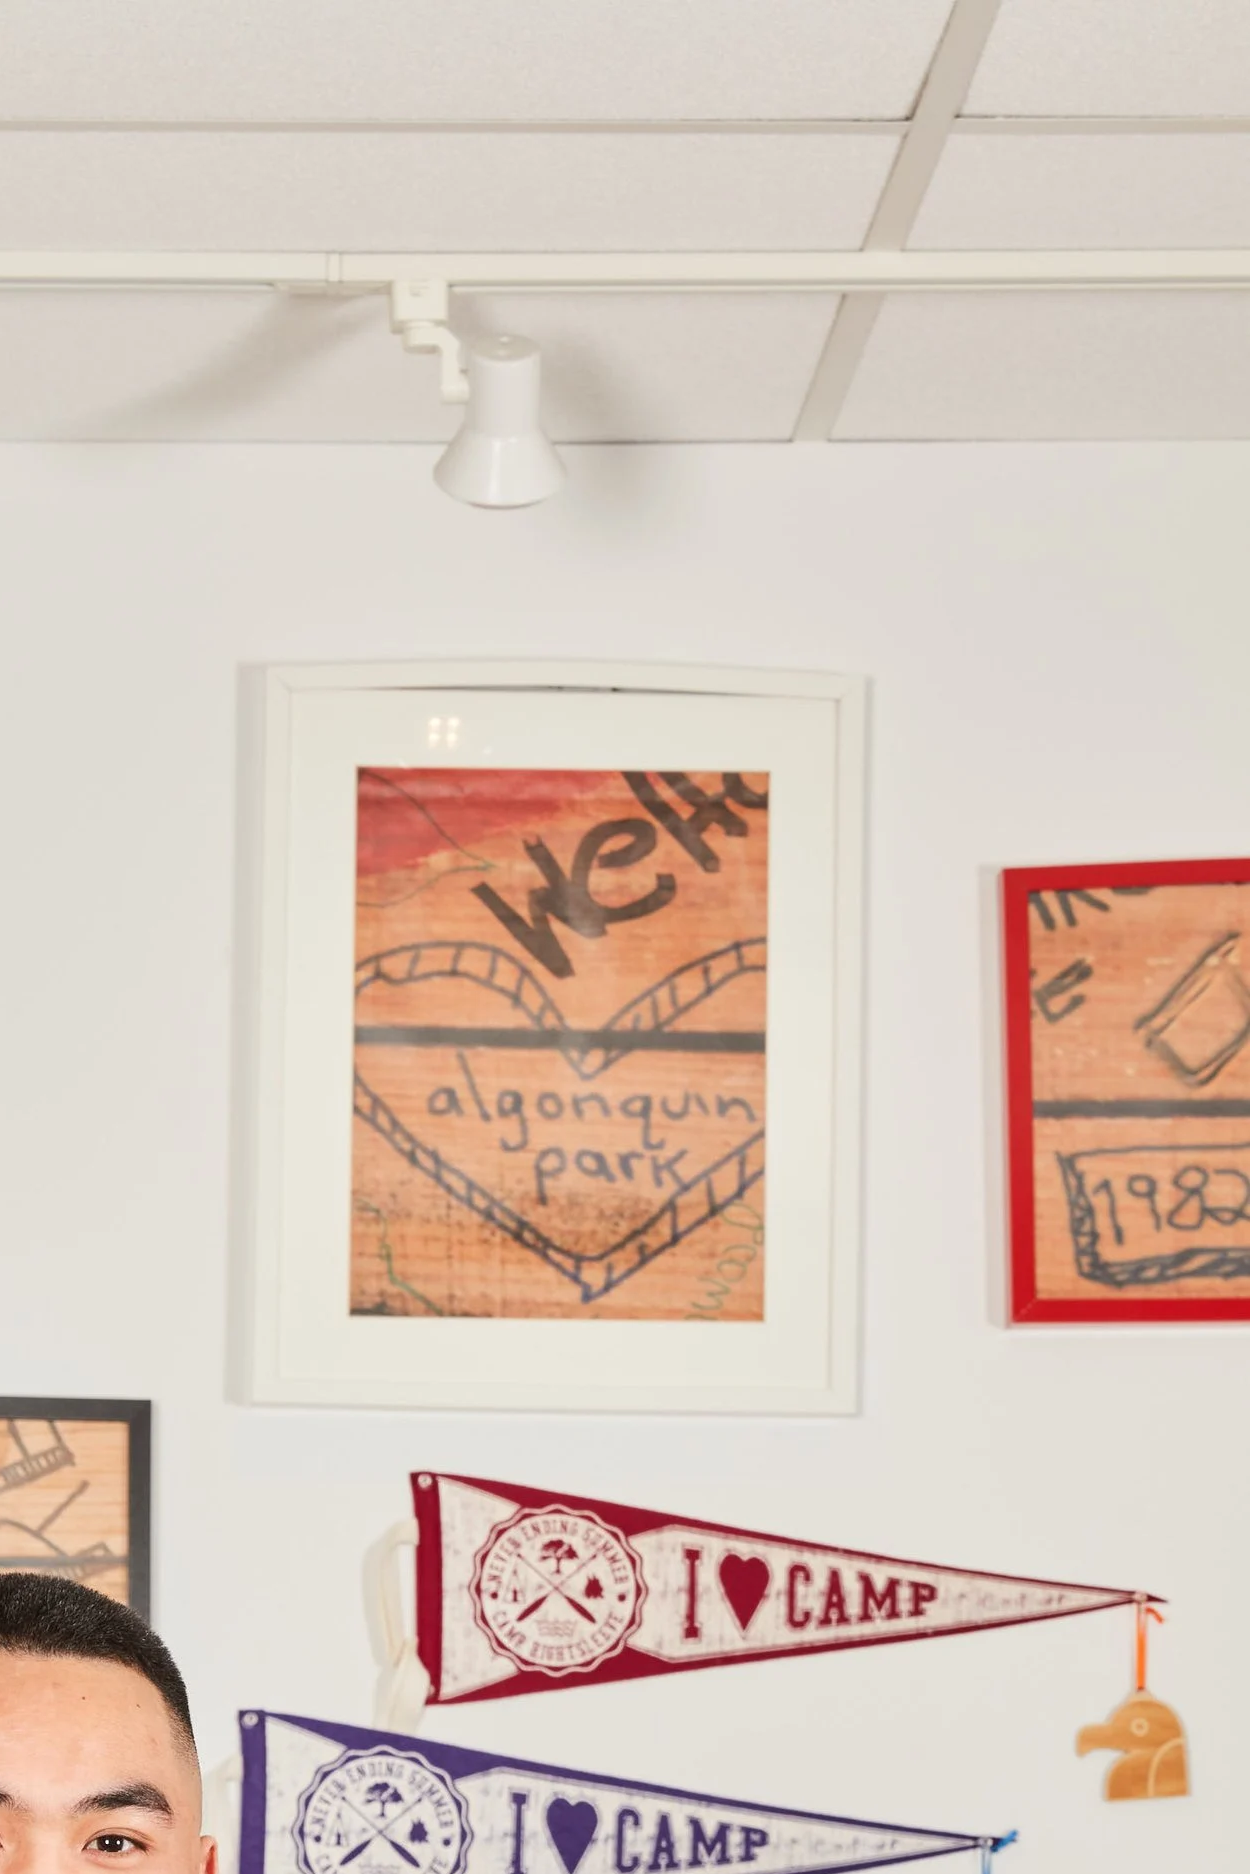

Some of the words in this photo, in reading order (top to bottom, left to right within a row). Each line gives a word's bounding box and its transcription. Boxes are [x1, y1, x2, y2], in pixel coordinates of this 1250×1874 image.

[427, 1050, 756, 1152] algonquin
[535, 1148, 694, 1206] park
[1092, 1164, 1250, 1247] 1982
[487, 1536, 522, 1584] NEVER
[521, 1519, 579, 1541] ENDING
[582, 1527, 630, 1585] SUMMER
[683, 1548, 701, 1640] I
[786, 1562, 939, 1631] CAMP
[492, 1610, 527, 1647] CAMP
[312, 1778, 347, 1827] NEVER
[345, 1761, 405, 1783] ENDING
[408, 1769, 455, 1829] SUMMER
[614, 1807, 770, 1874] CAMP
